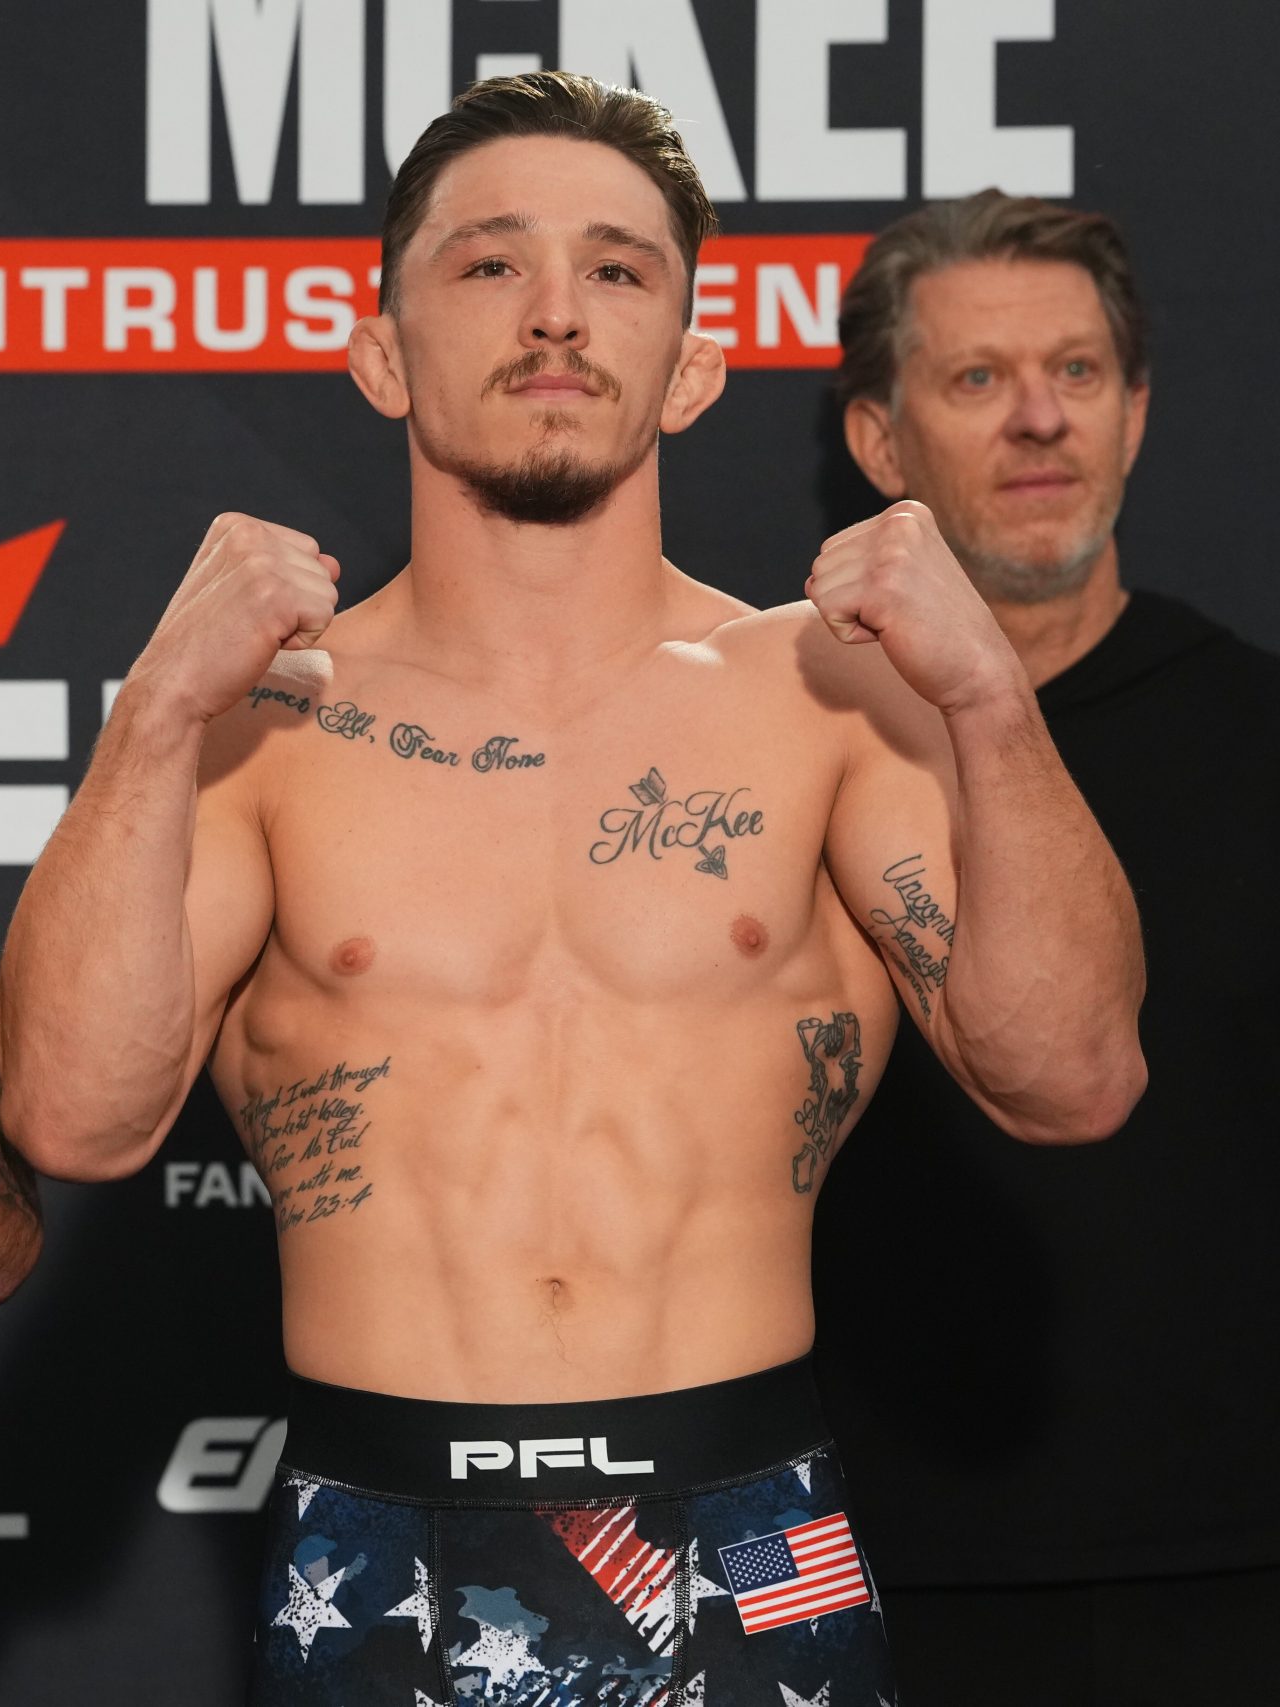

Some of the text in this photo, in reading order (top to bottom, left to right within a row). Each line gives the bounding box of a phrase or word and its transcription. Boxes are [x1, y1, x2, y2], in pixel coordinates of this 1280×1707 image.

[389, 723, 461, 767] Fear
[471, 736, 546, 773] None
[589, 787, 764, 865] McKee
[330, 1056, 391, 1092] through
[306, 1183, 373, 1223] 23:4
[449, 1436, 655, 1480] PFL
